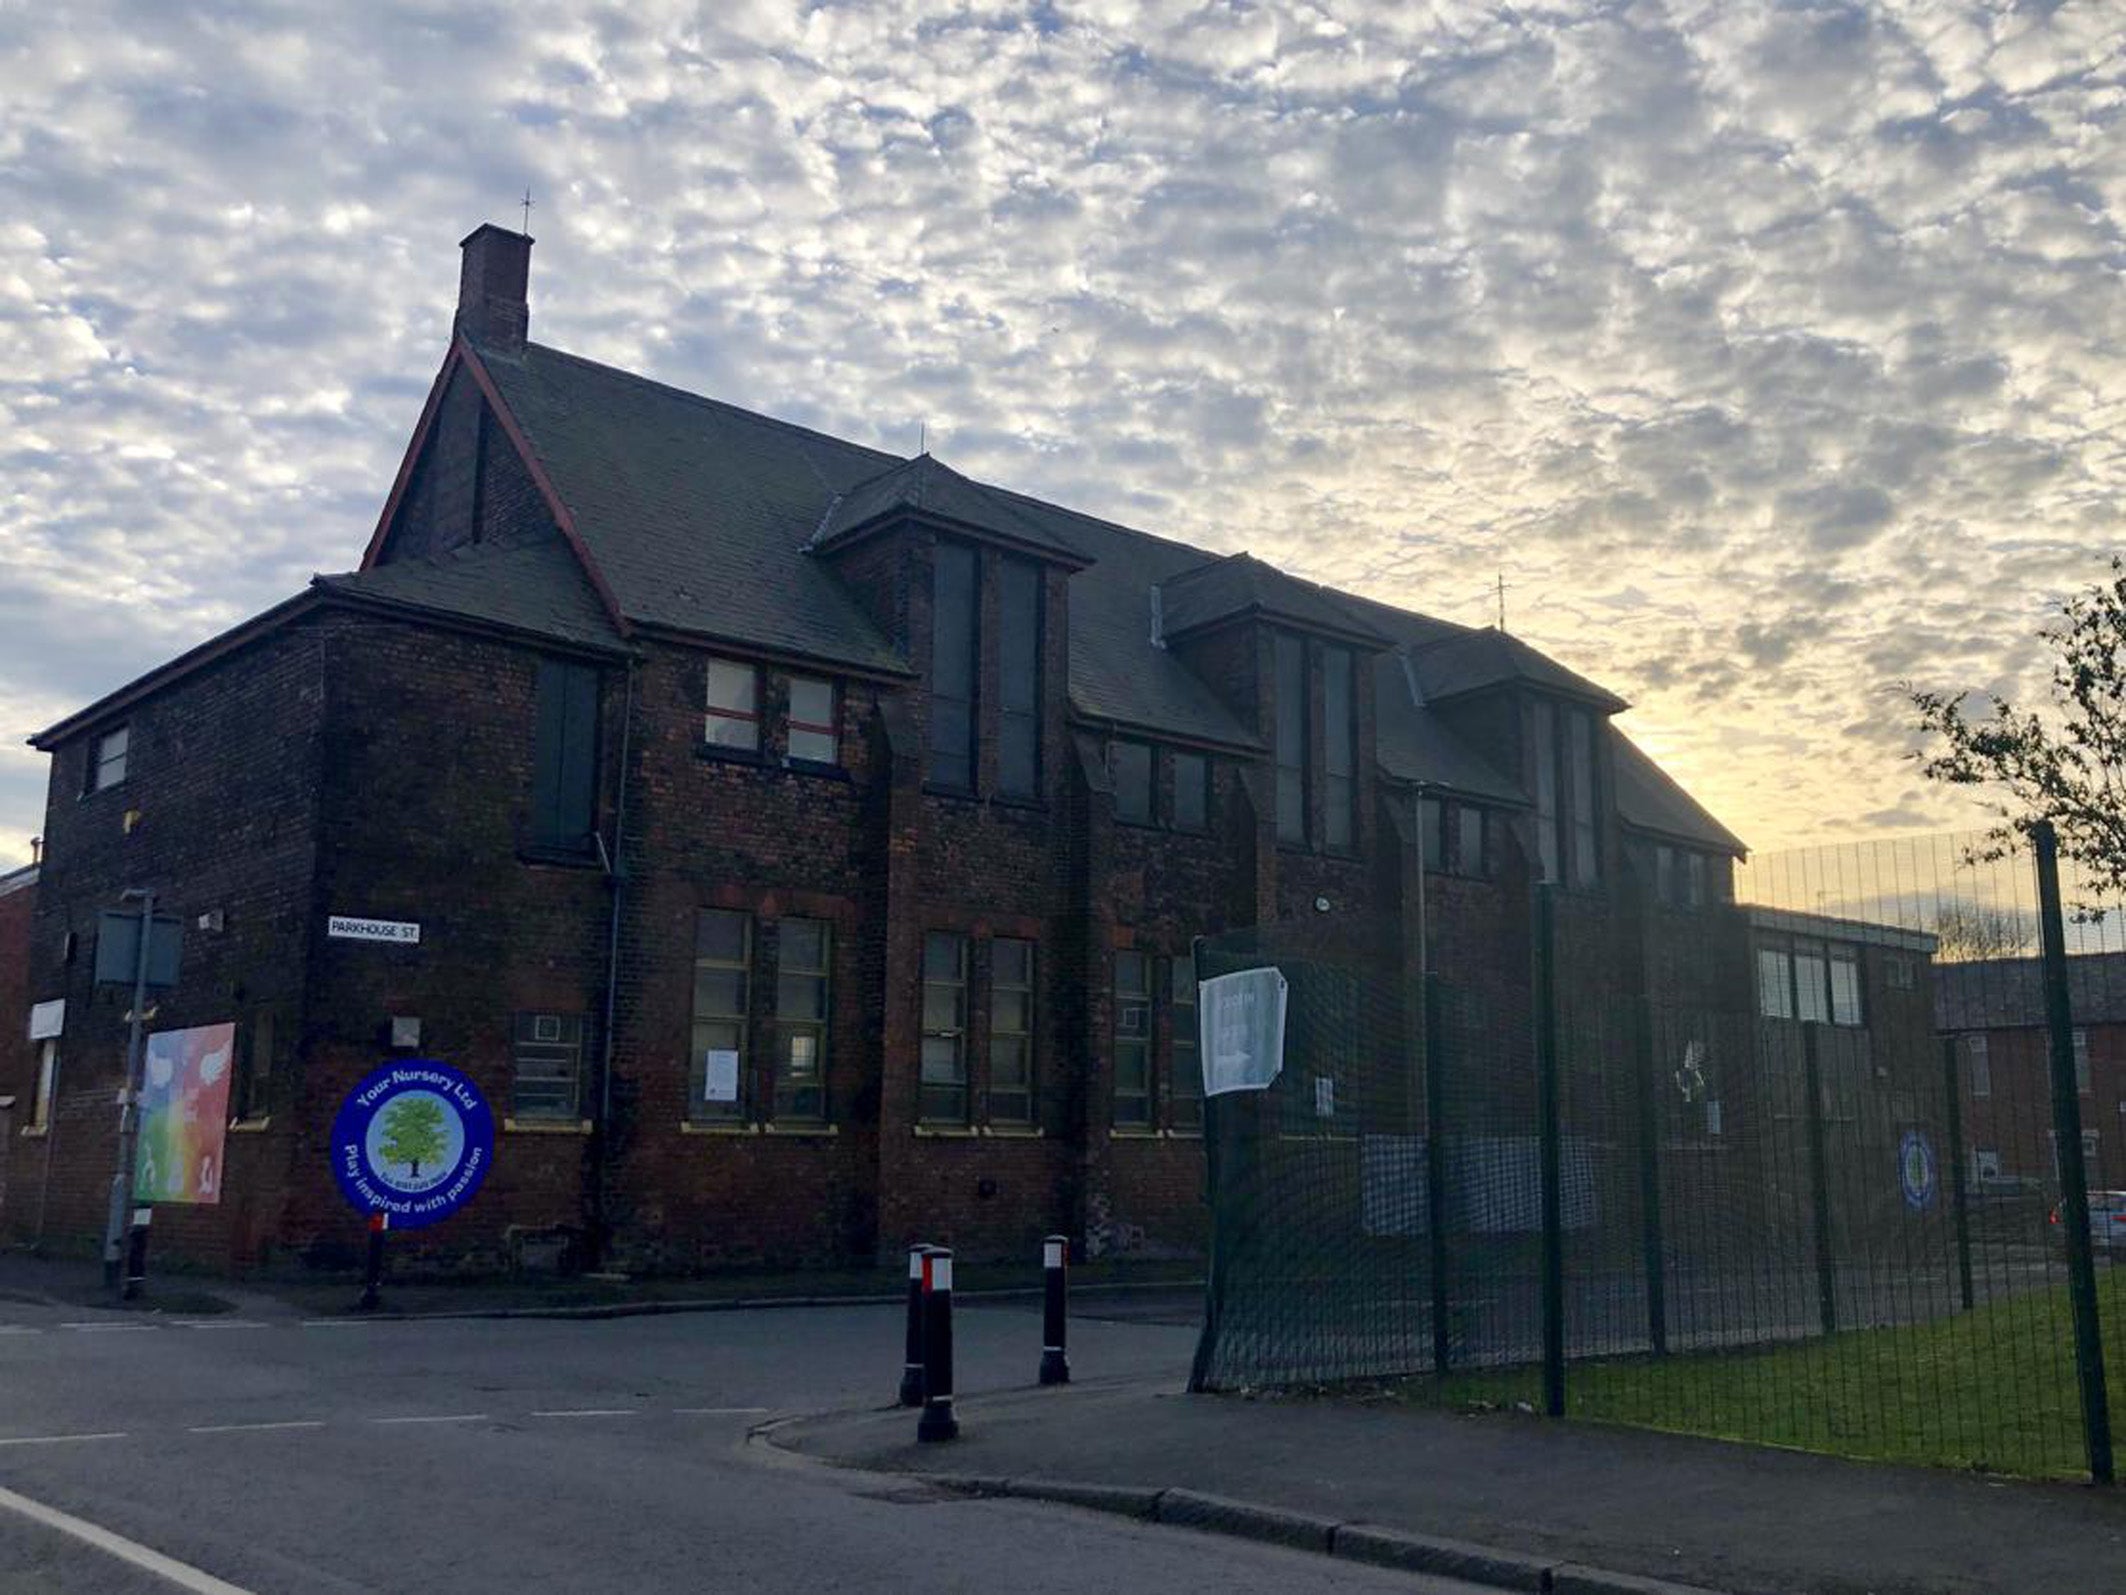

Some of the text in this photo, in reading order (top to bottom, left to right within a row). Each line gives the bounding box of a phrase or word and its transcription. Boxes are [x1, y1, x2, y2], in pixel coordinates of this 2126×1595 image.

[332, 920, 397, 937] PARKHOUSE
[357, 1069, 477, 1110] Your Nursery Ltd
[345, 1144, 360, 1178] Play
[356, 1177, 411, 1213] inspired
[414, 1194, 446, 1213] with
[447, 1147, 482, 1201] passion
